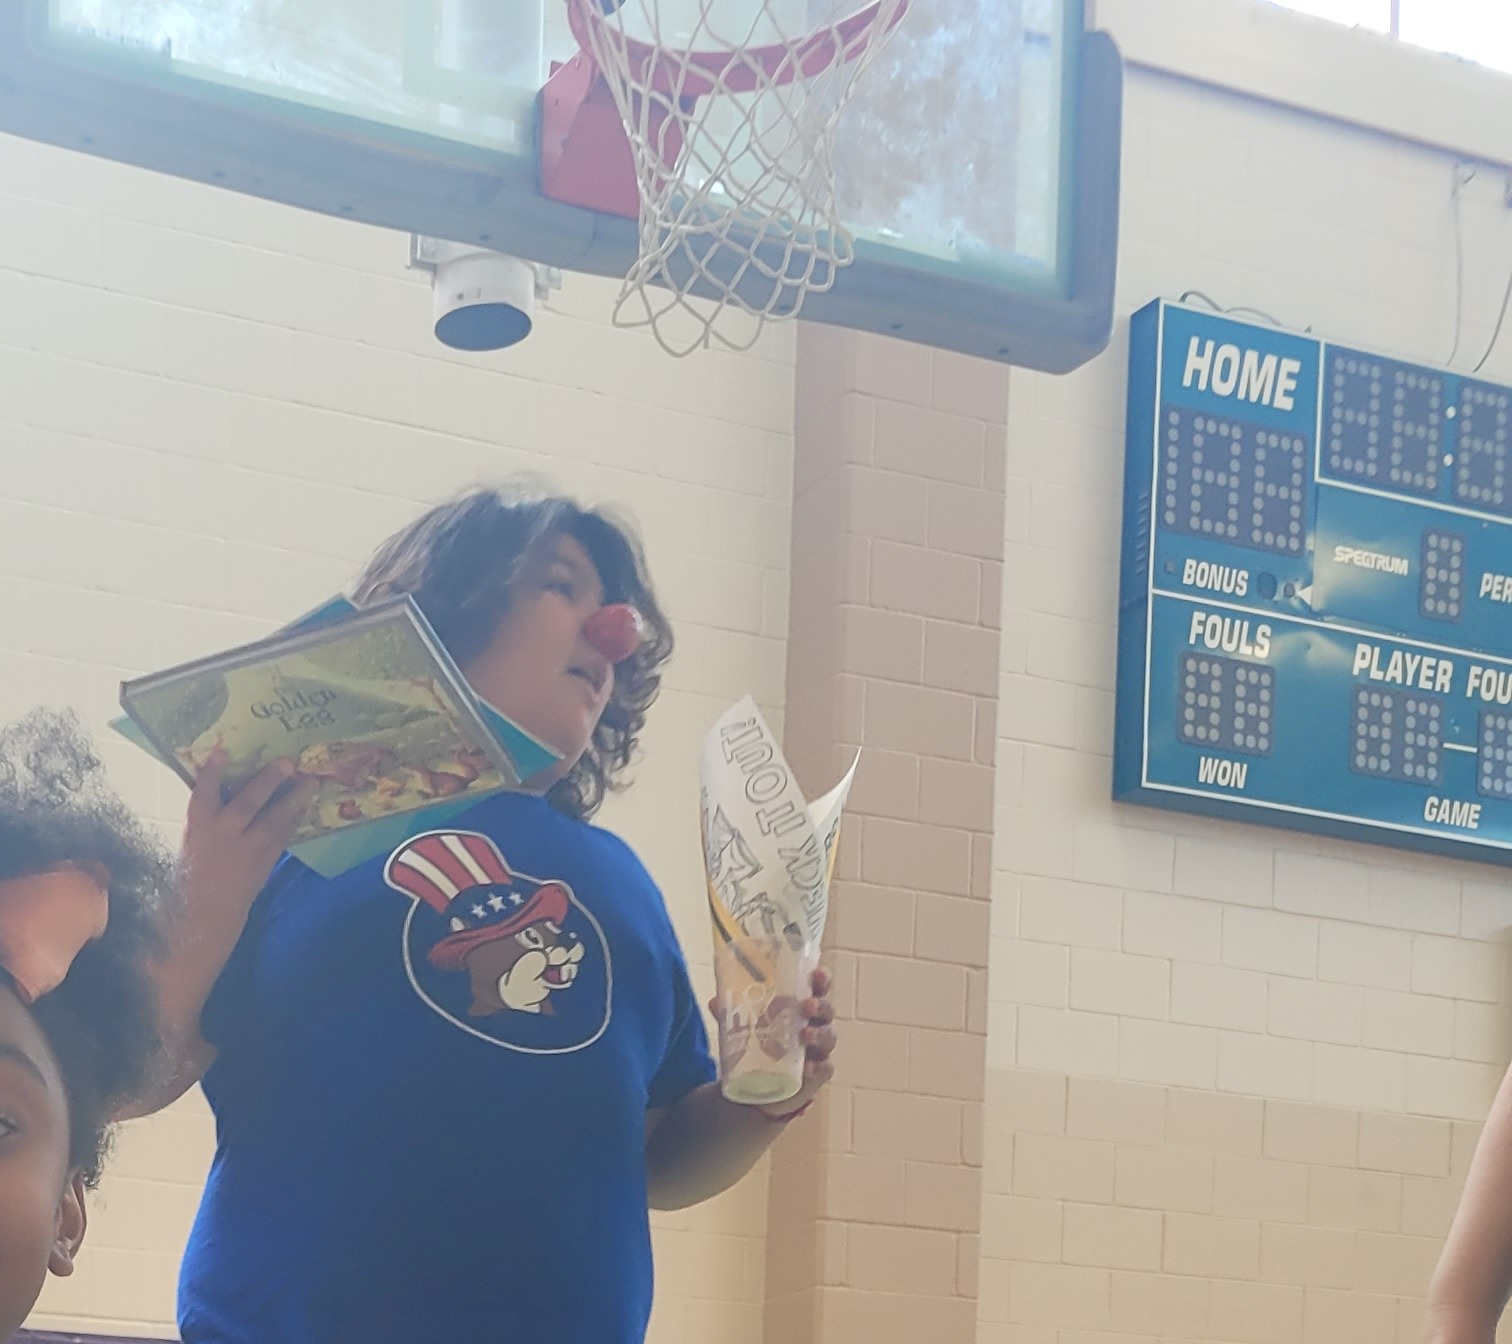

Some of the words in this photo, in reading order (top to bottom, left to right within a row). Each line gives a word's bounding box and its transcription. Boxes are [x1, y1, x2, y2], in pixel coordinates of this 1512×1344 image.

[1182, 336, 1301, 411] HOME
[1182, 559, 1249, 597] BONUS
[1333, 545, 1408, 576] SPECTRUM
[1188, 611, 1272, 658] FOULS
[1352, 643, 1454, 694] PLAYER
[720, 717, 788, 806] OUT!
[1198, 756, 1248, 789] WON
[1424, 796, 1481, 829] GAME
